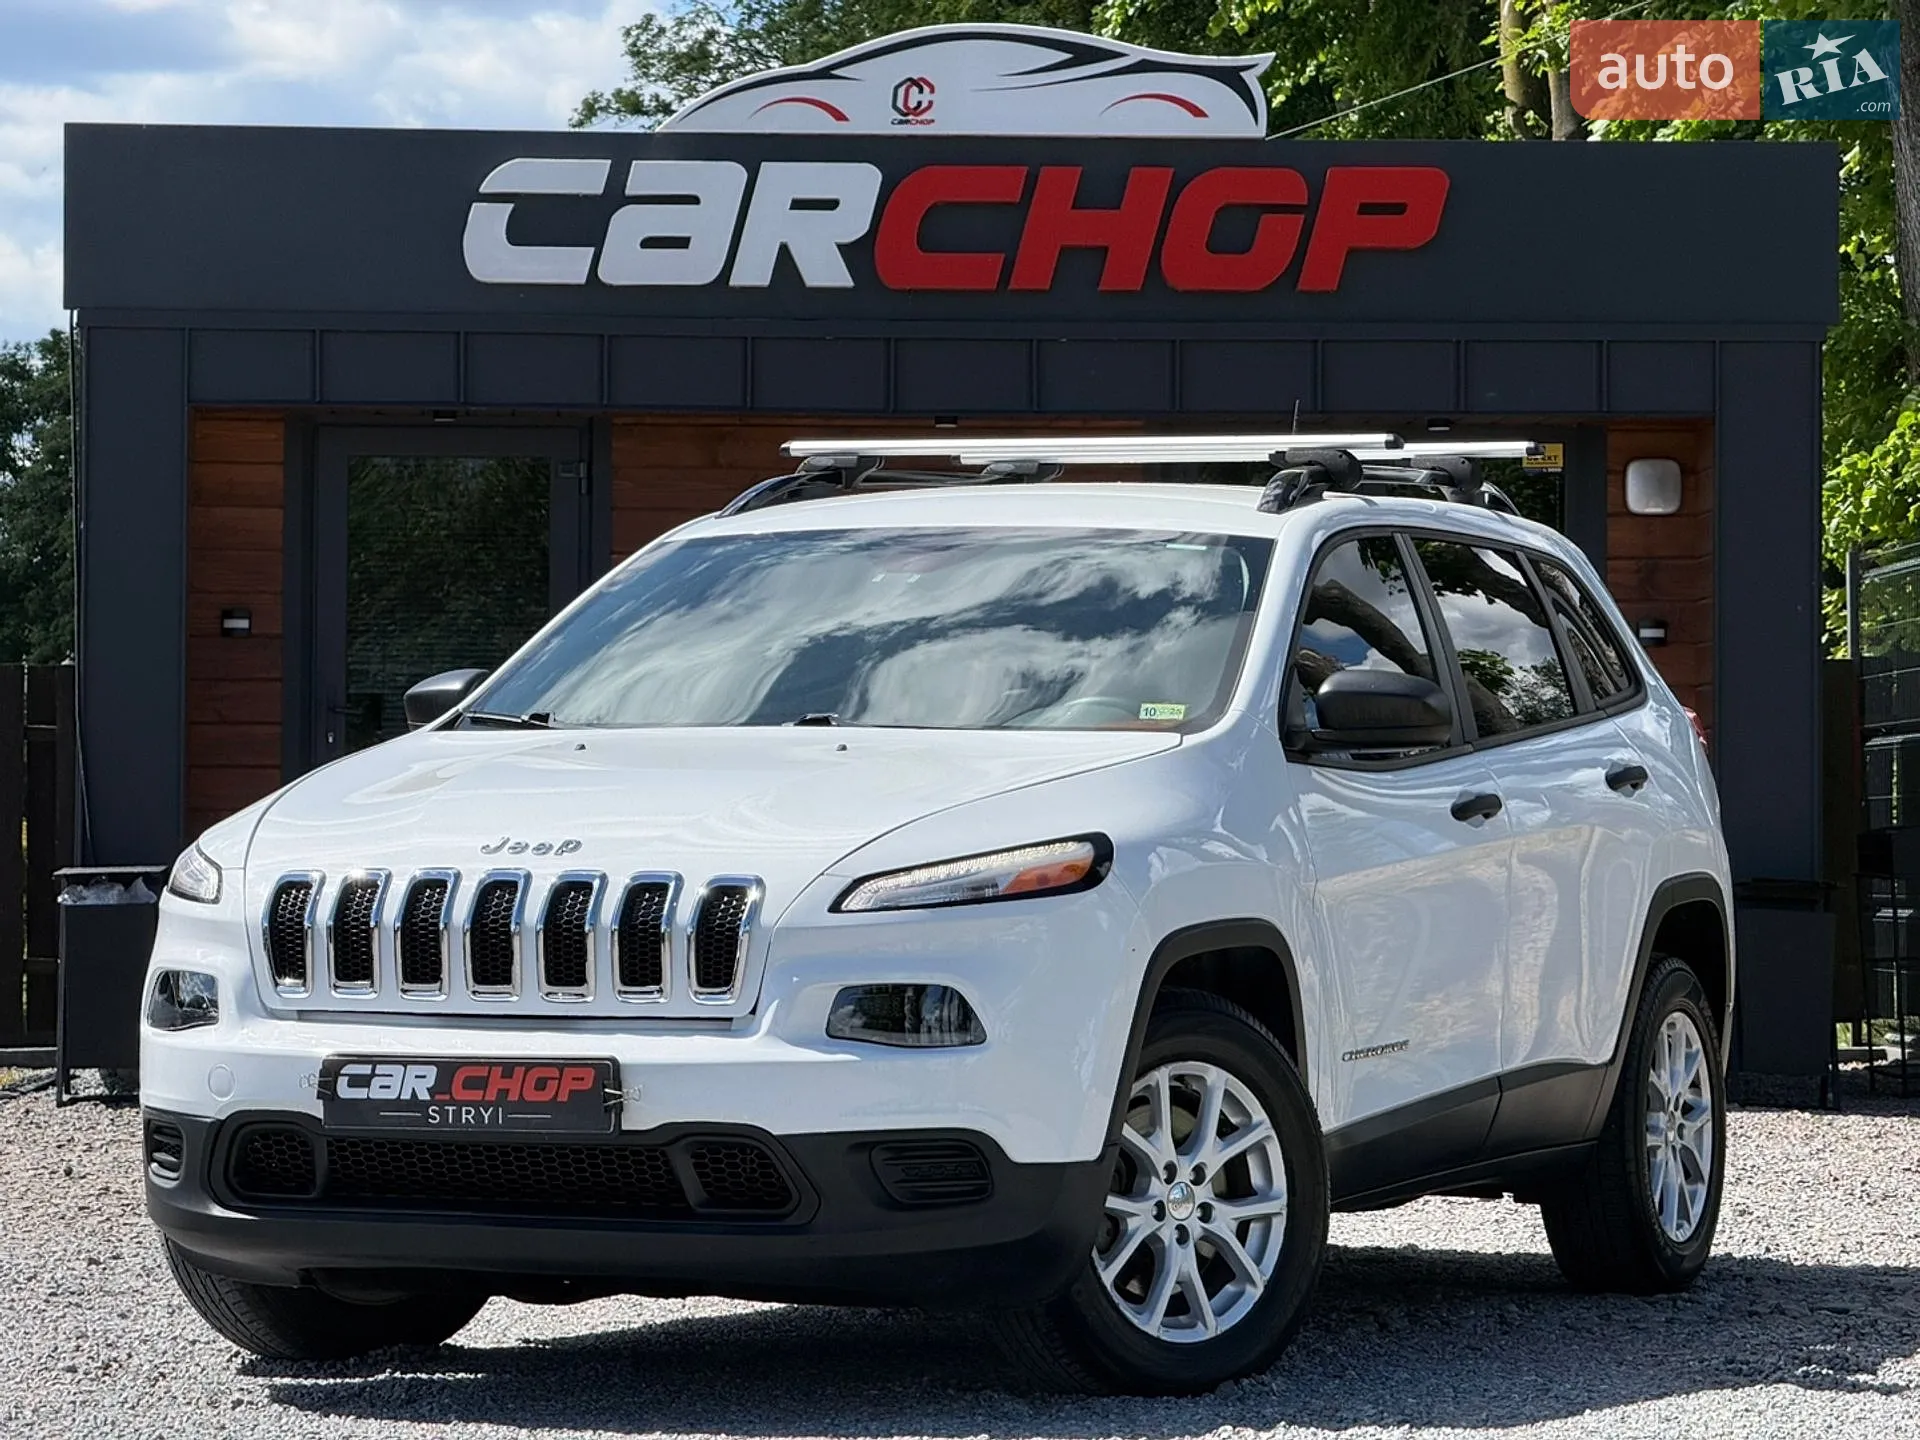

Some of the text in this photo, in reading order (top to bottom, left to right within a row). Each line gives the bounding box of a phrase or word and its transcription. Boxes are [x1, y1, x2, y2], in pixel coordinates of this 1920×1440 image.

[1143, 707, 1157, 717] 10
[480, 836, 583, 857] Jeep
[427, 1106, 504, 1125] STRYI
